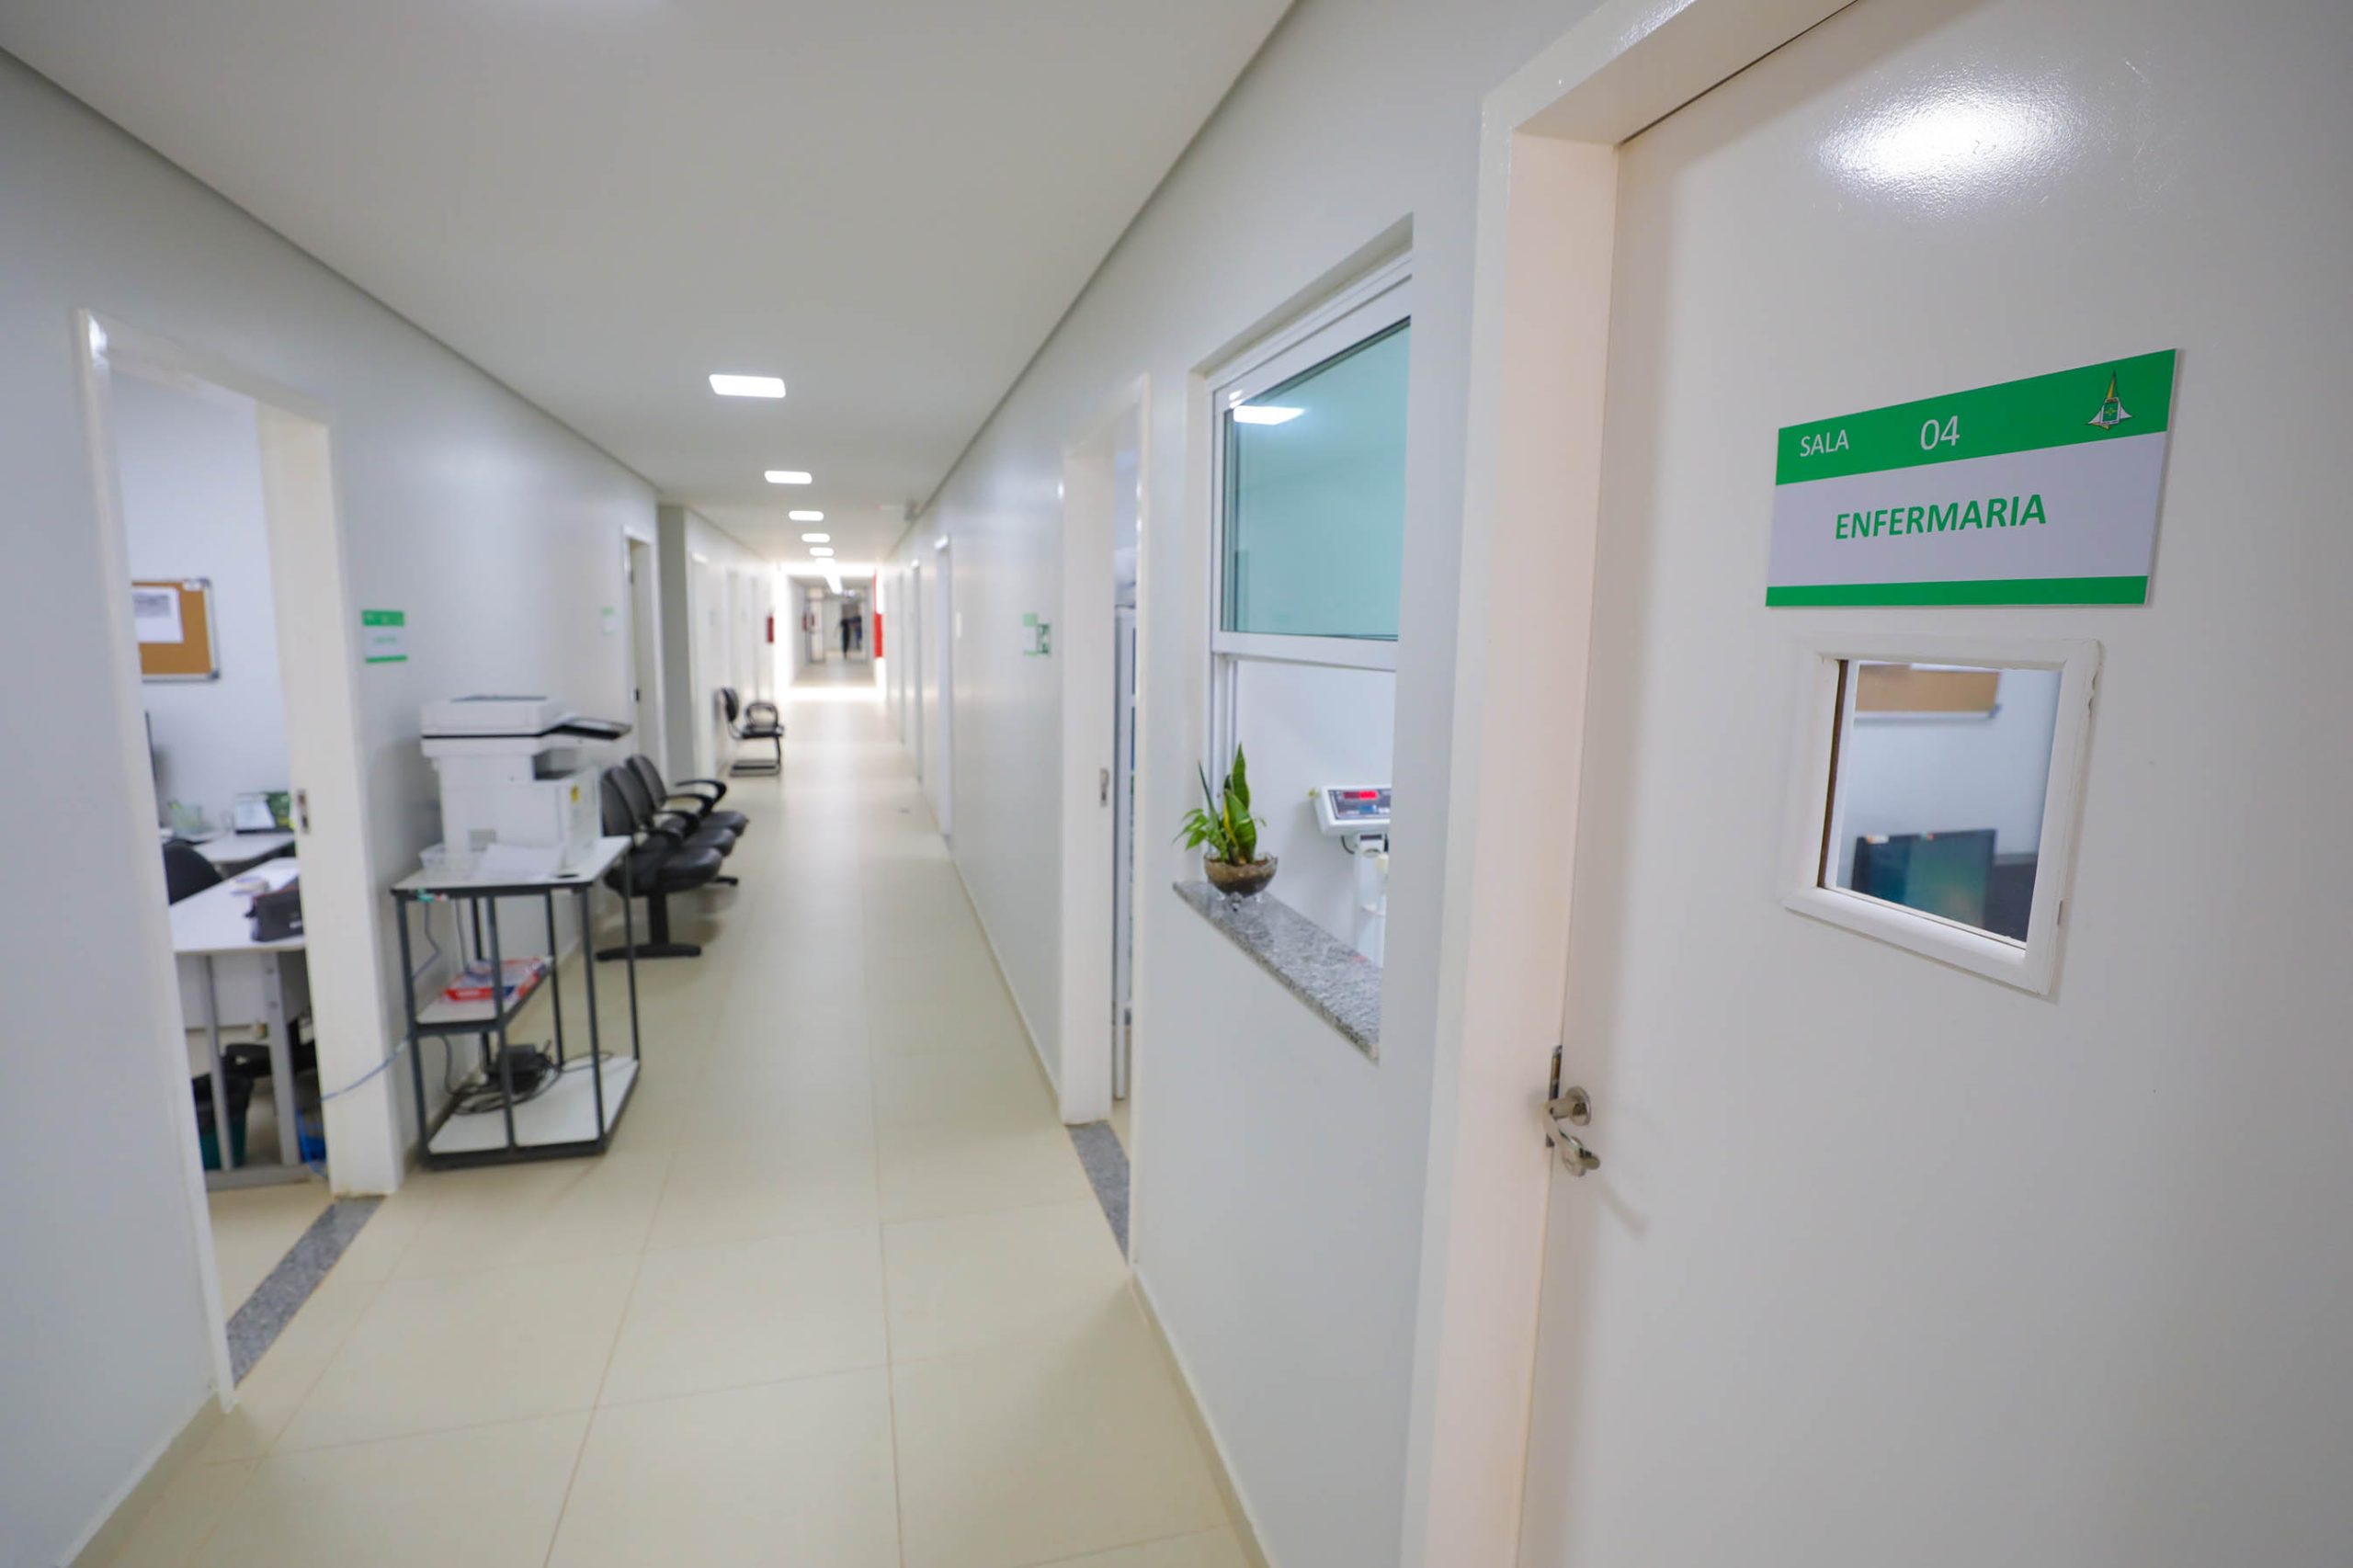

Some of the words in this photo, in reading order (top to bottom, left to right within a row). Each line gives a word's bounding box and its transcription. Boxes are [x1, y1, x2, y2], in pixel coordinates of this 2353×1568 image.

[1800, 429, 1849, 457] SALA
[1920, 415, 1961, 450] 04
[1836, 494, 2046, 540] ENFERMARIA
